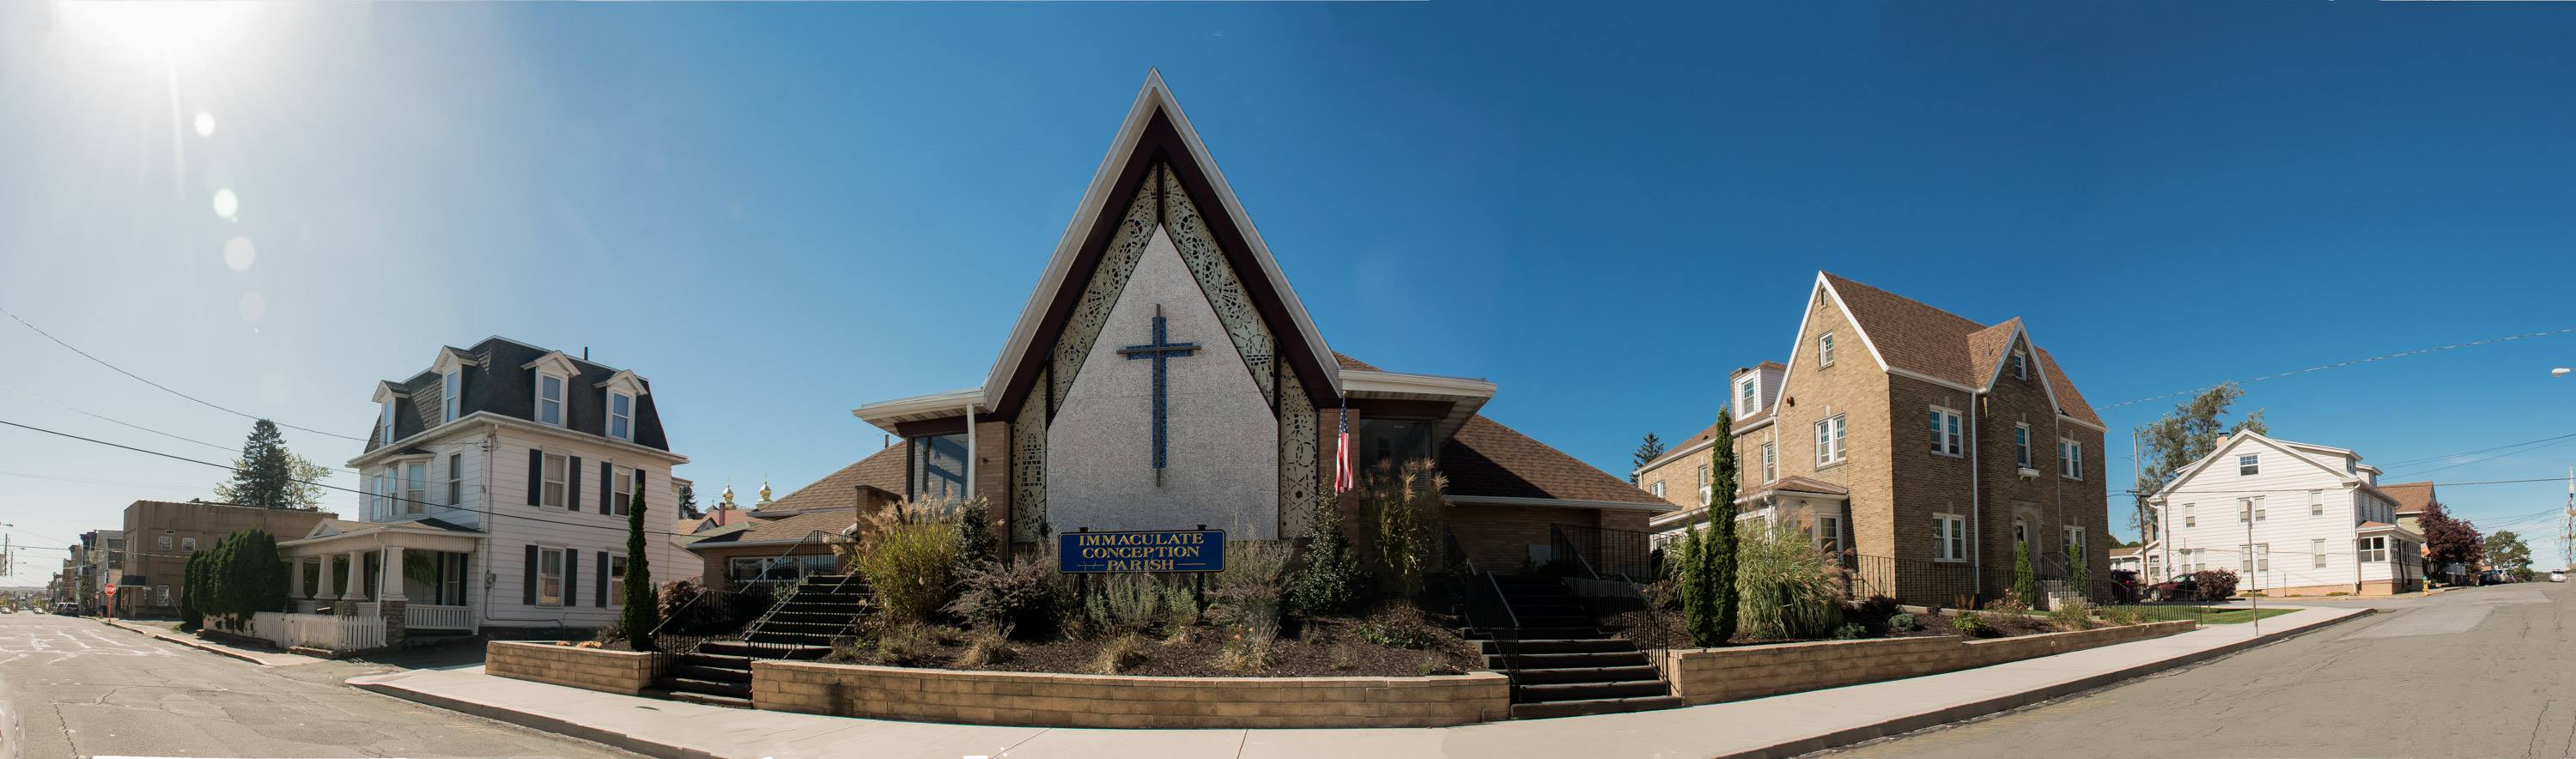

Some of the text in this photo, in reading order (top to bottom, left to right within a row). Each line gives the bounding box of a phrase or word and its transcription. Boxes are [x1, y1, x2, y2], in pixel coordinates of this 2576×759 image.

[1079, 533, 1204, 546] IMMACULATE
[1082, 546, 1200, 558] CONCEPTION
[1107, 559, 1174, 571] PARISH
